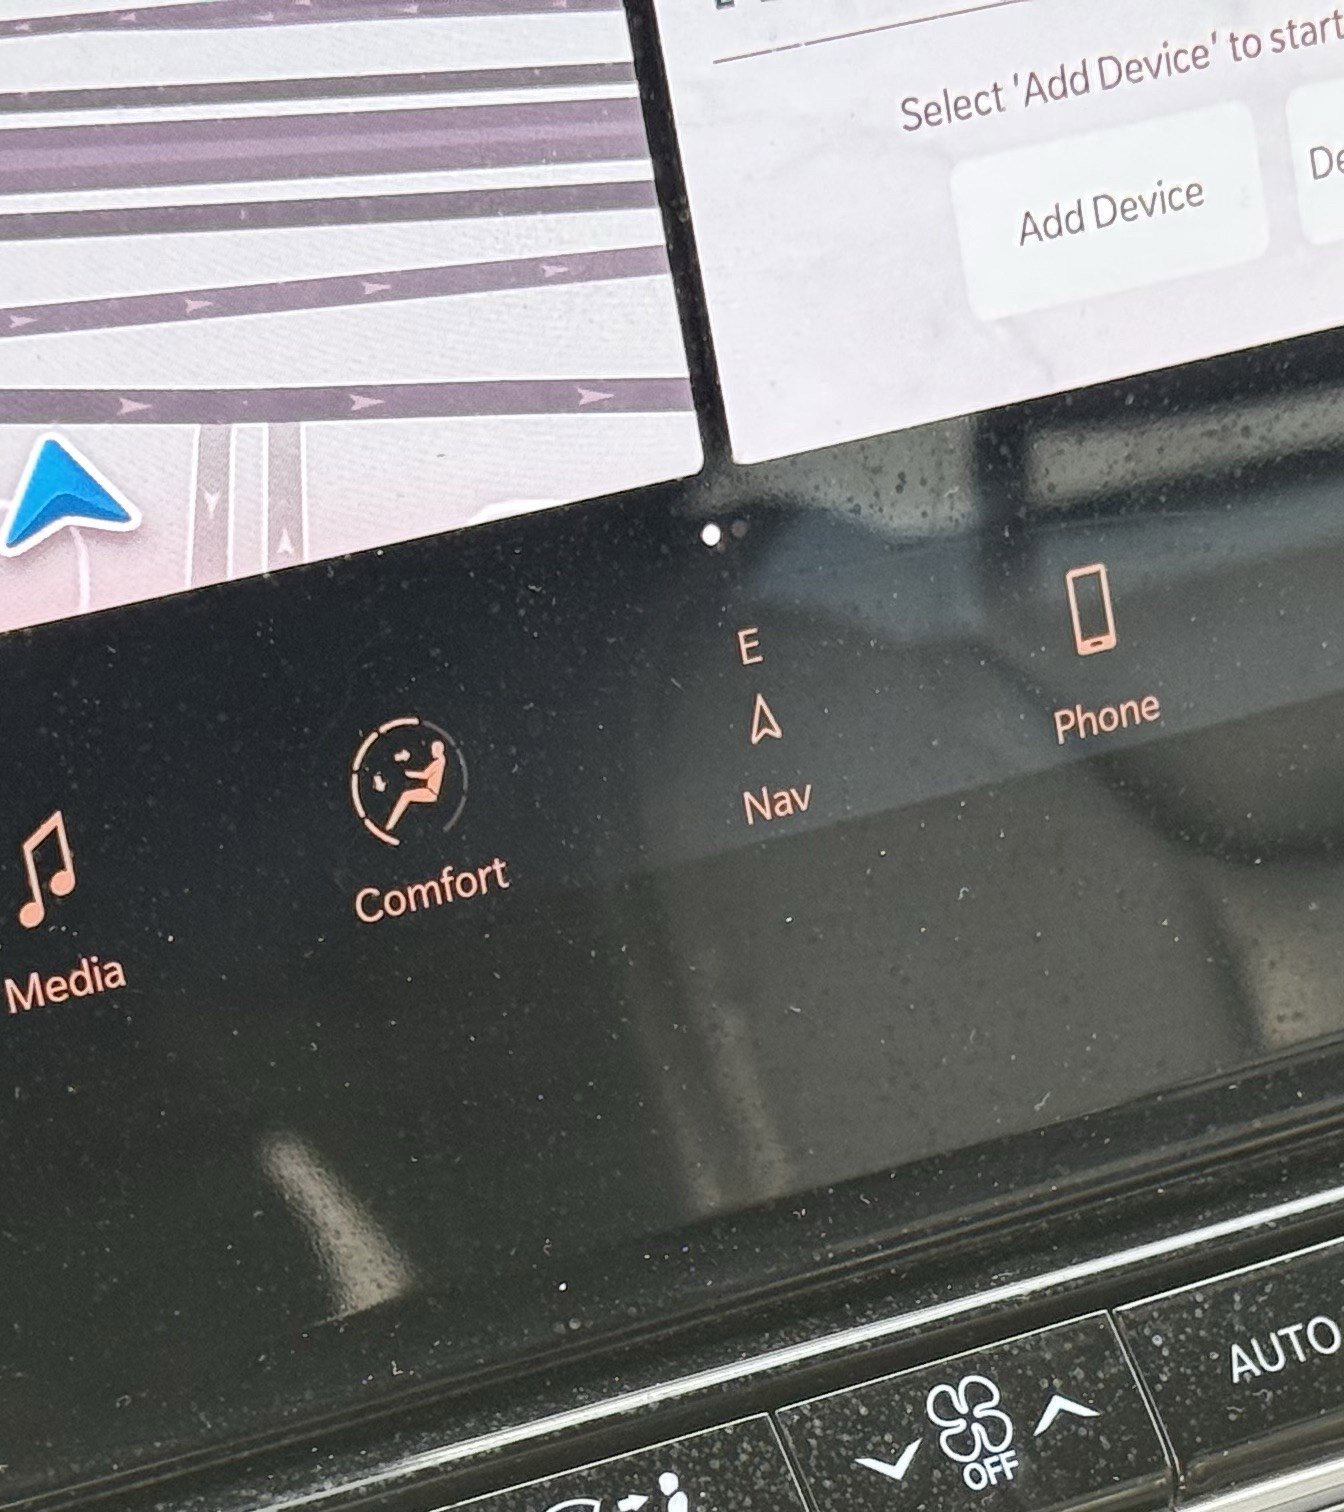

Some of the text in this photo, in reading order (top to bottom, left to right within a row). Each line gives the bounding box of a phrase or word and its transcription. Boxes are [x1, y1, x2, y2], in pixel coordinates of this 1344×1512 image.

[901, 83, 1006, 132] Select
[1014, 59, 1090, 107] 'Add
[1099, 31, 1218, 90] Device'
[1229, 28, 1263, 63] to
[1018, 179, 1205, 247] Add Device
[737, 627, 763, 667] E
[1053, 690, 1162, 745] Phone
[741, 782, 814, 826] Nav
[354, 855, 512, 924] Comfort
[3, 954, 129, 1014] Media
[1229, 1313, 1342, 1384] AUTO
[961, 1450, 1020, 1493] OFF
